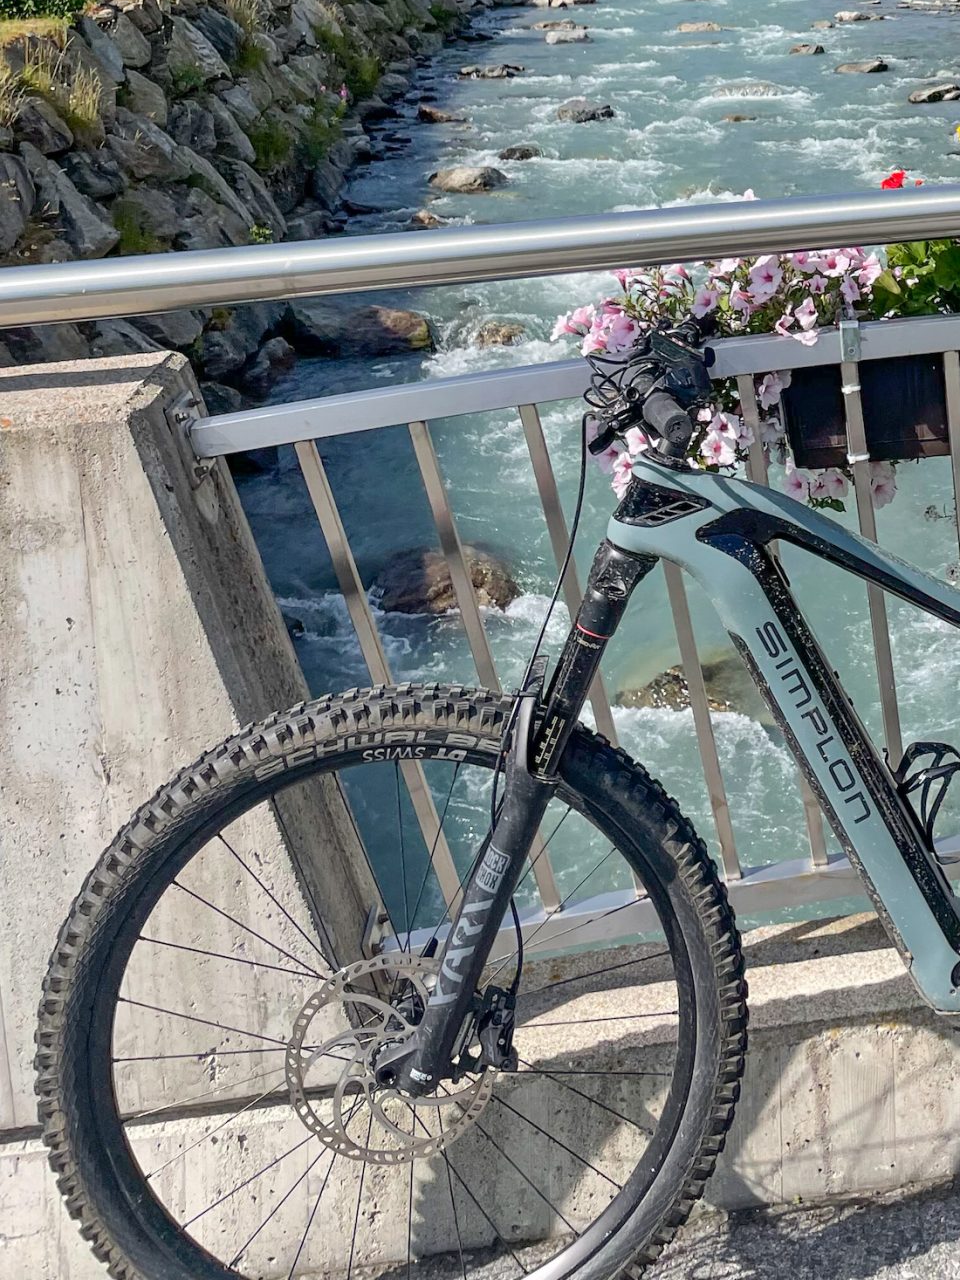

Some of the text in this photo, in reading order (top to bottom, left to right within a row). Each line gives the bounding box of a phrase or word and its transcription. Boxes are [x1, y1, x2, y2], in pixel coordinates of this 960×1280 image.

[755, 621, 871, 824] SIMPLON
[253, 731, 501, 782] SCHWALBE
[362, 747, 468, 763] DT SWISS
